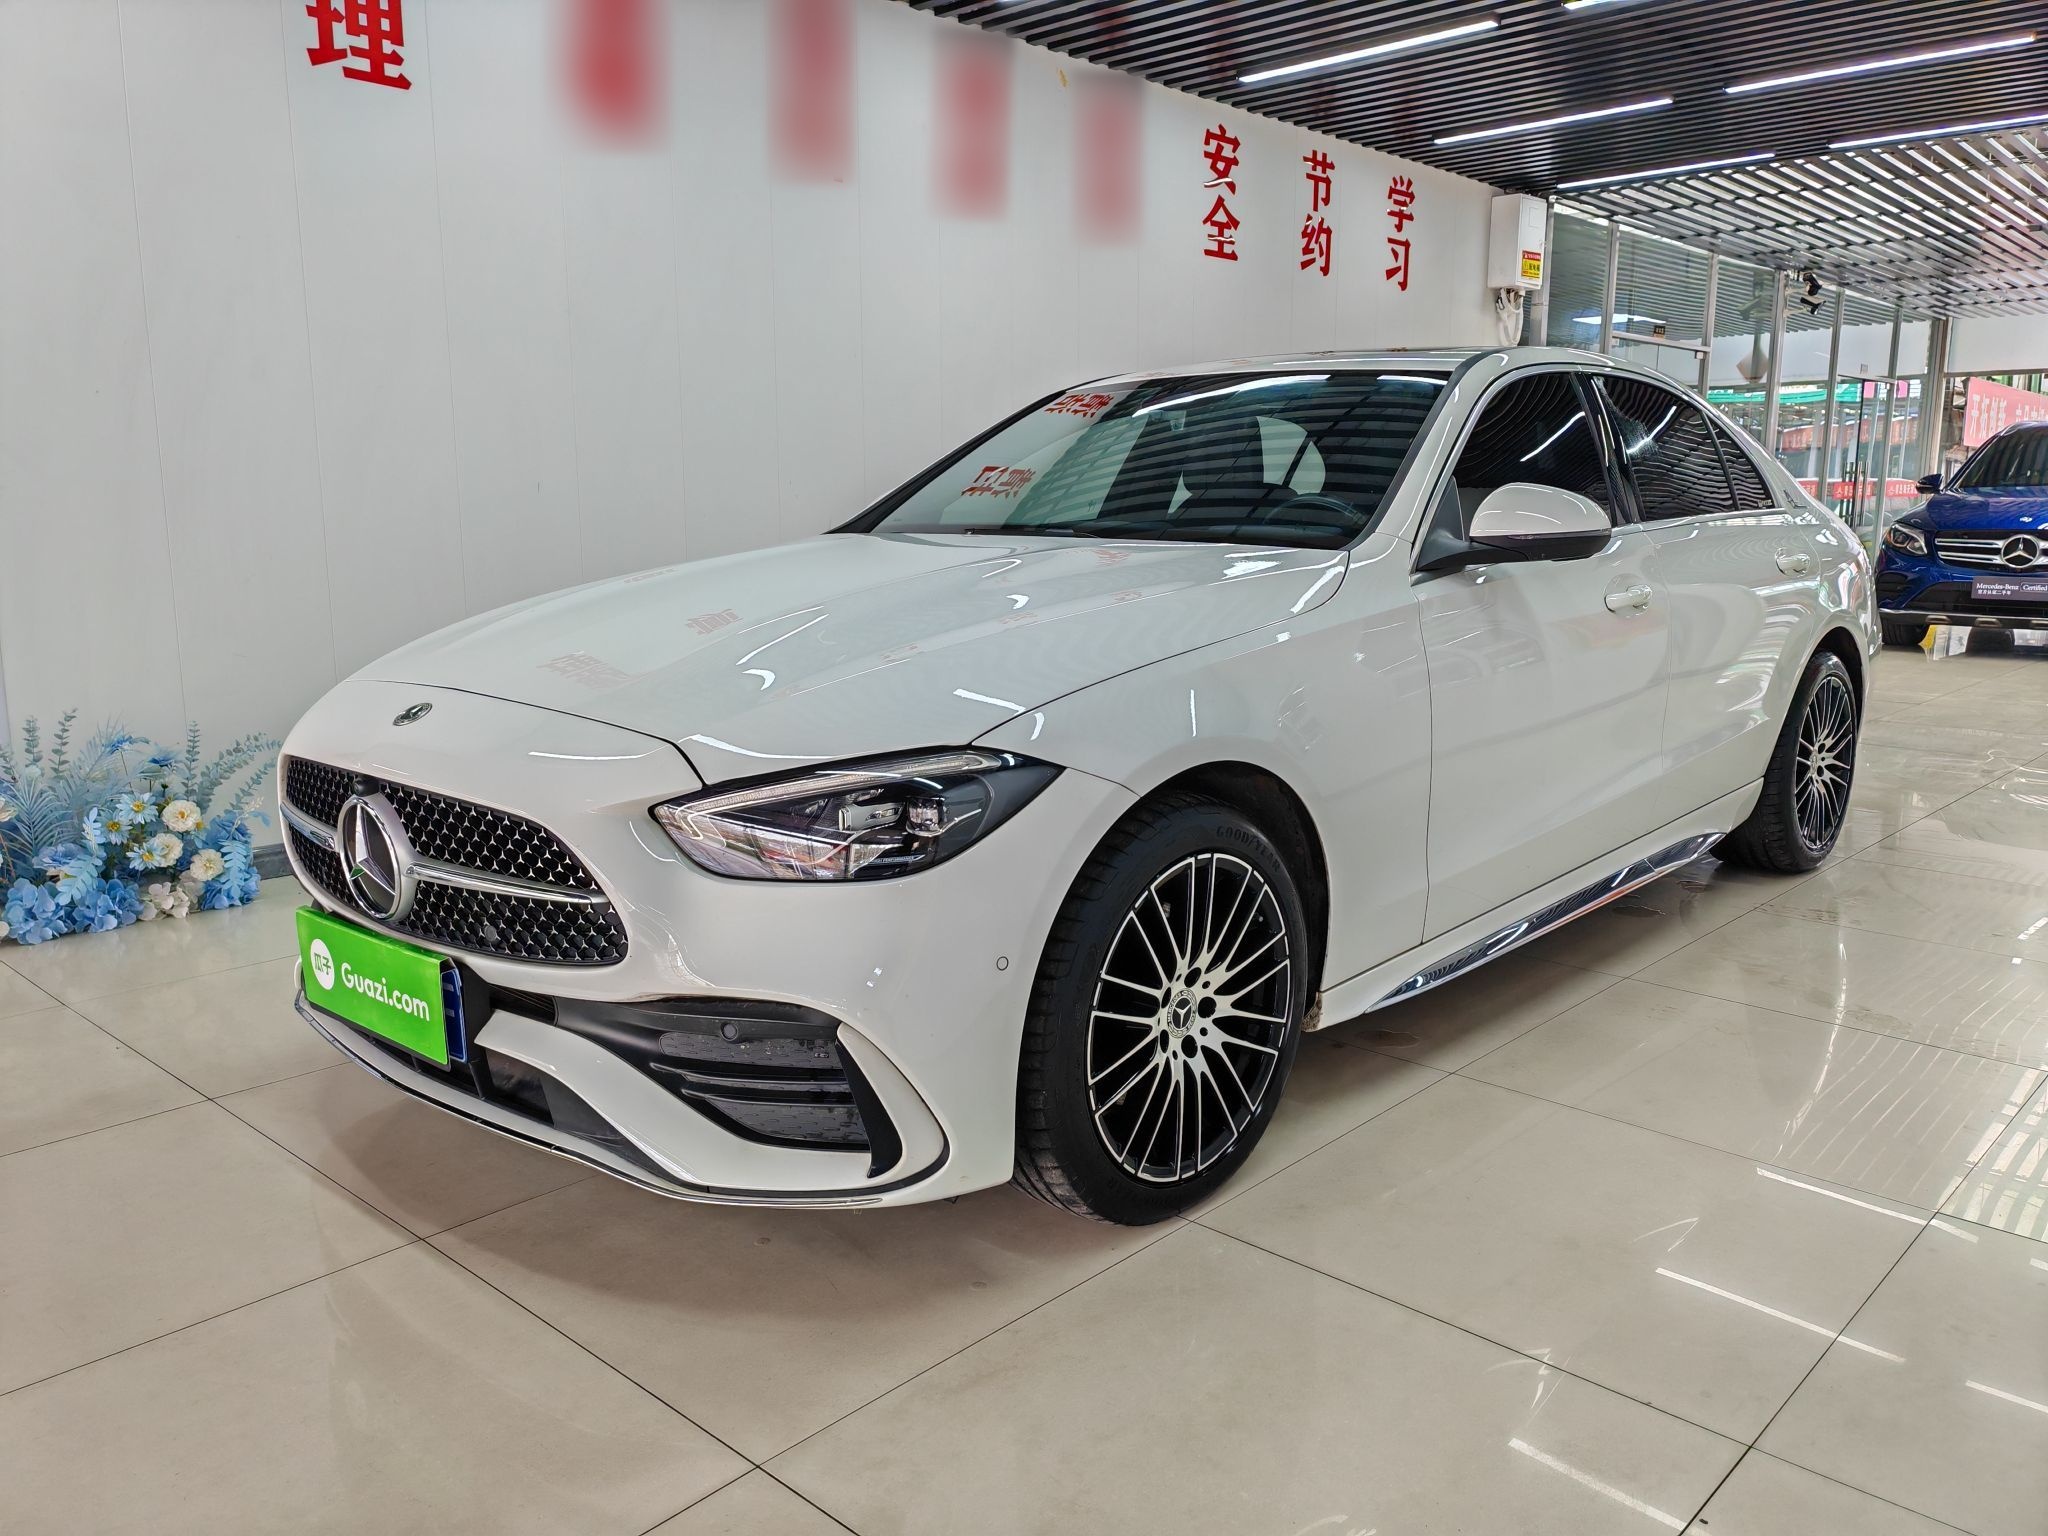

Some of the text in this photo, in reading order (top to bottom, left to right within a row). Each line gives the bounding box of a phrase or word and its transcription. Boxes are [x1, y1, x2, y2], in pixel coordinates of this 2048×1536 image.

[306, 0, 412, 90] 理
[1203, 124, 1241, 261] 安全
[1300, 149, 1335, 277] 节约
[1385, 175, 1415, 291] 学习
[314, 952, 332, 975] 瓜子
[341, 962, 430, 1021] Guazi.com
